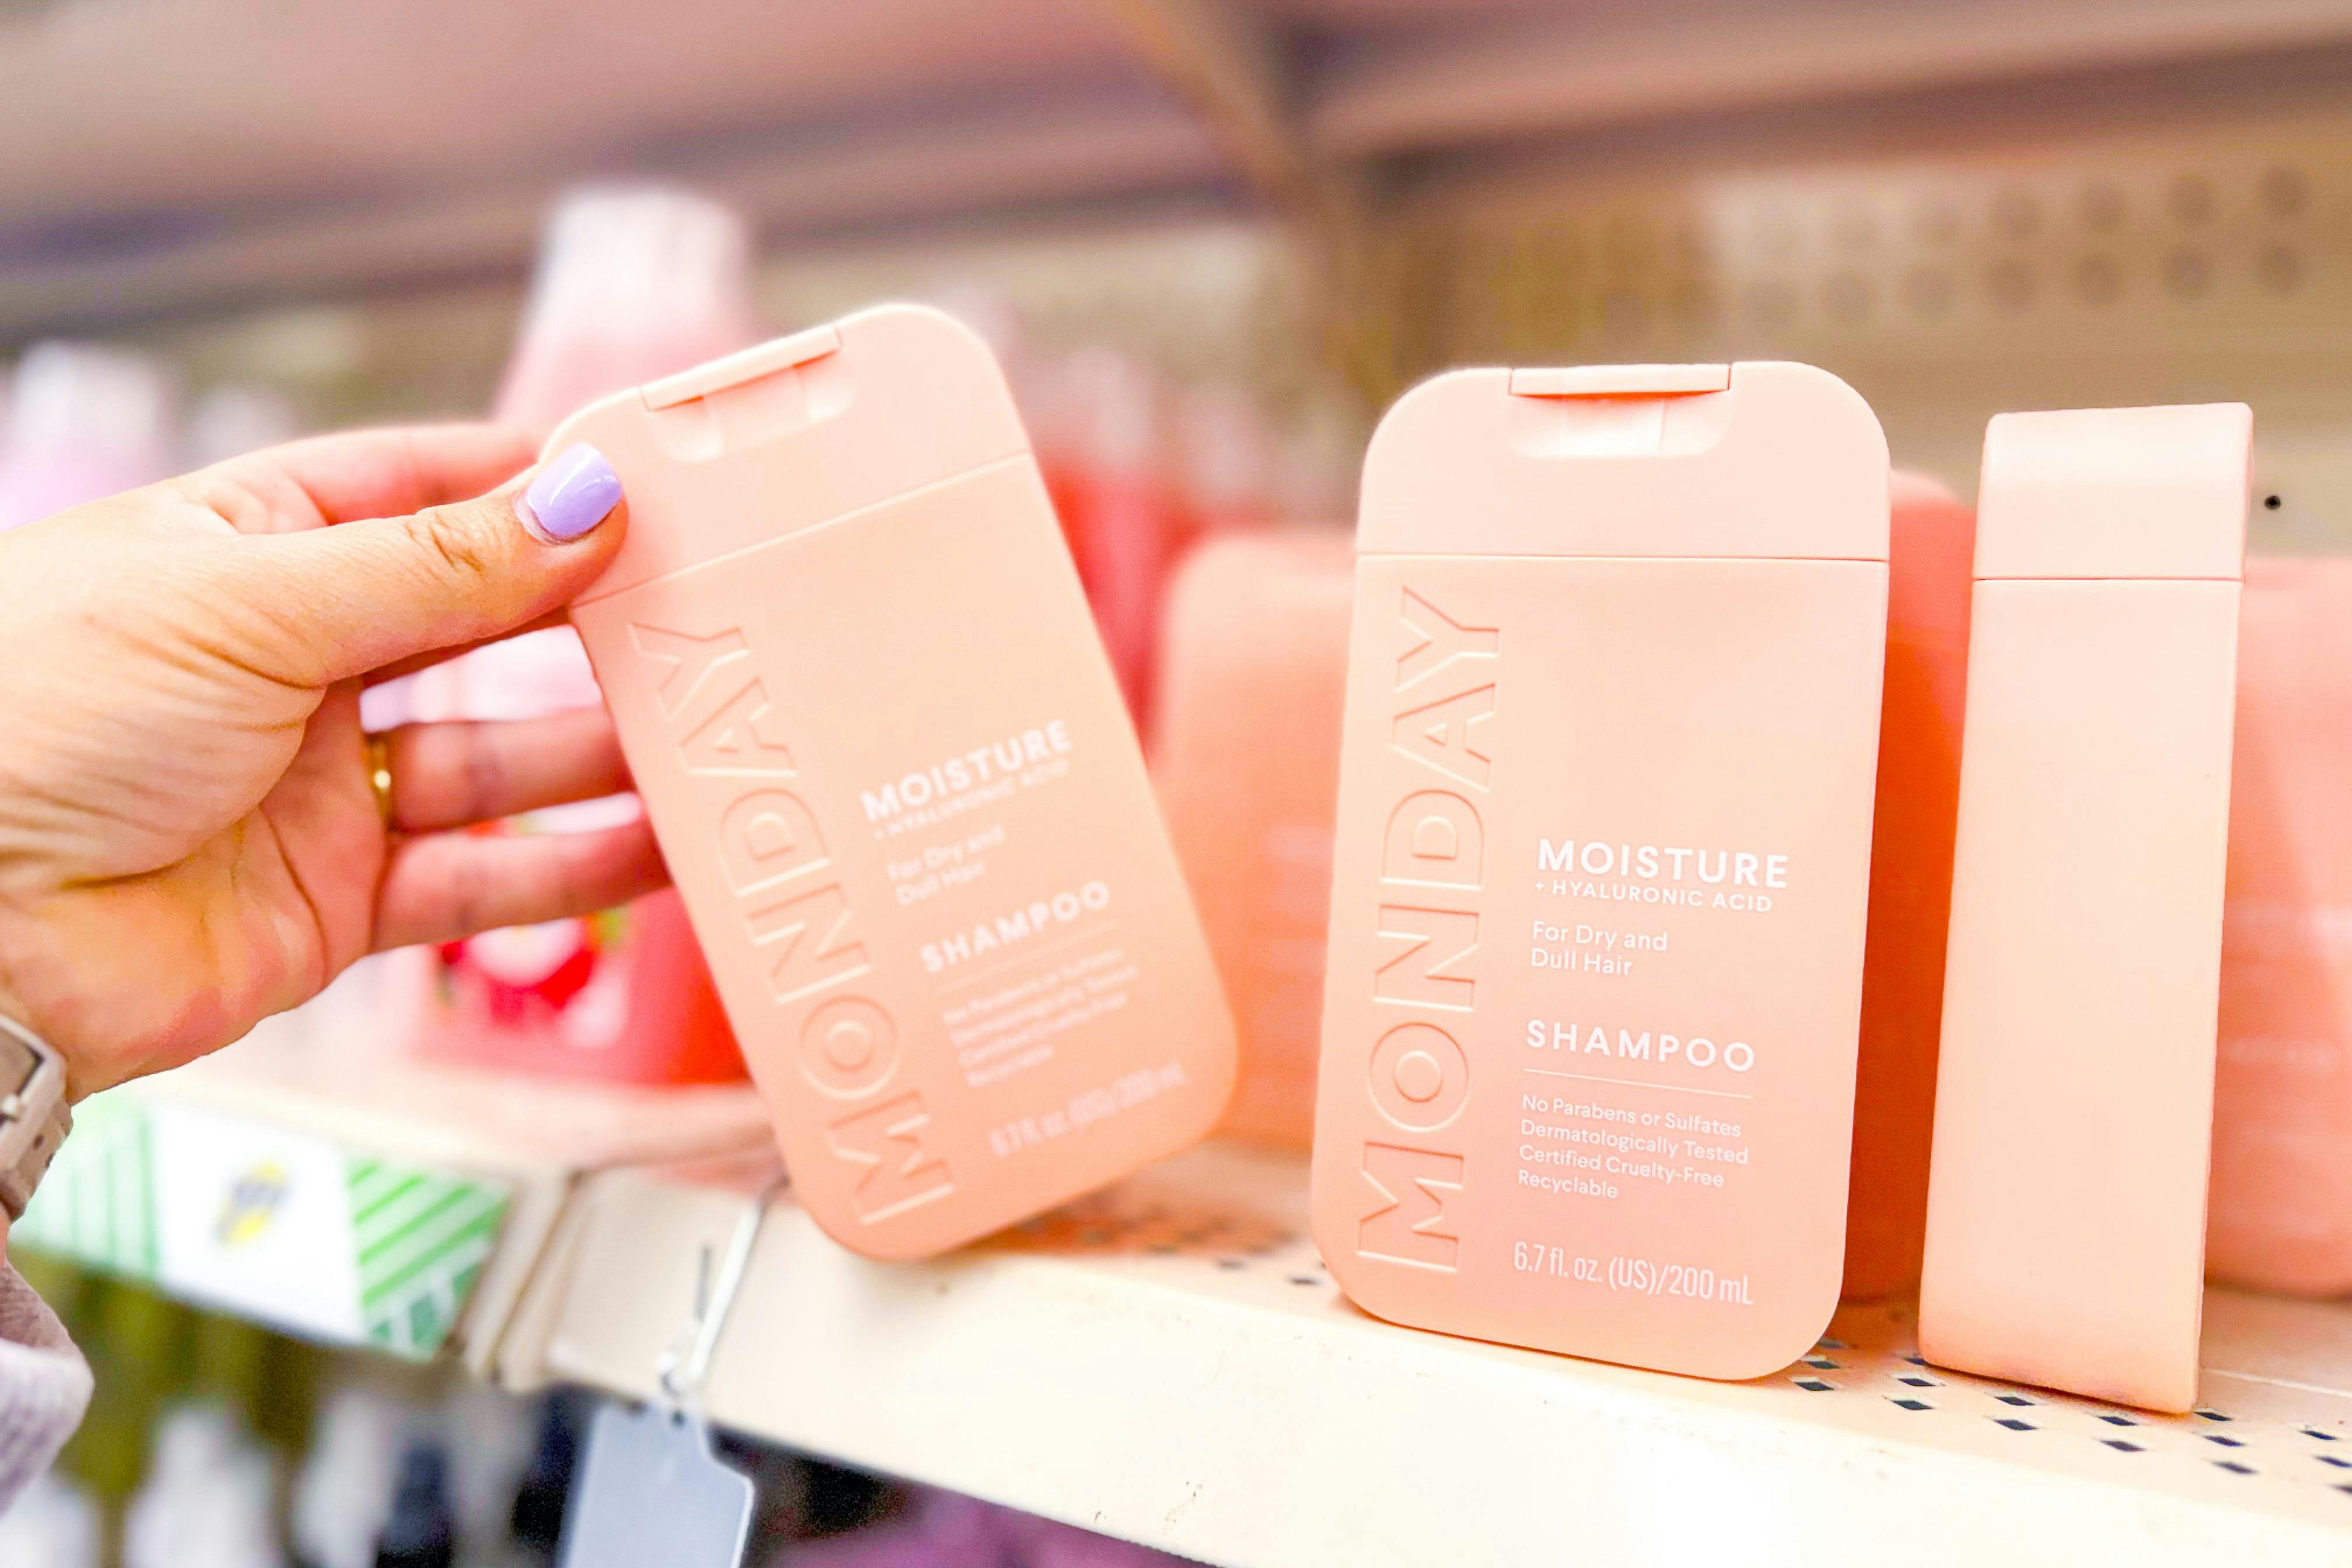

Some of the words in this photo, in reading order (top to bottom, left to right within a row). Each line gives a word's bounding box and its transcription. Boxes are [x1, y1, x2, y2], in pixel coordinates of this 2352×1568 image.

[860, 719, 1073, 821] MOISTURE
[1537, 838, 1789, 888] MOISTURE
[1552, 879, 1703, 907] HYALURONIC
[1712, 892, 1773, 912] ACID
[628, 621, 954, 1224] MONDAY
[920, 880, 1110, 973] SHAMPOO
[1357, 585, 1500, 1273] MONDAY
[1532, 919, 1569, 943] For
[1575, 924, 1618, 953] Dry
[1623, 931, 1668, 952] and
[1530, 947, 1577, 971] Dull
[1584, 951, 1633, 976] Hair
[1525, 1019, 1755, 1072] SHAMPOO
[1522, 1093, 1549, 1112] No
[1553, 1097, 1637, 1124] Parabens
[1640, 1112, 1661, 1126] or
[1665, 1112, 1742, 1138] Sulfates
[1518, 1143, 1602, 1170] Certified
[1605, 1156, 1725, 1188] Cruelty-Free
[1520, 1118, 1679, 1159] Dermatologically
[1683, 1140, 1749, 1166] Tested
[1518, 1168, 1619, 1199] Recyclable
[1513, 1240, 1546, 1273] 6.7
[1548, 1246, 1569, 1278] fl.
[1573, 1256, 1603, 1283] oz.
[1608, 1256, 1714, 1300] (US)/200
[1718, 1274, 1755, 1306] mL
